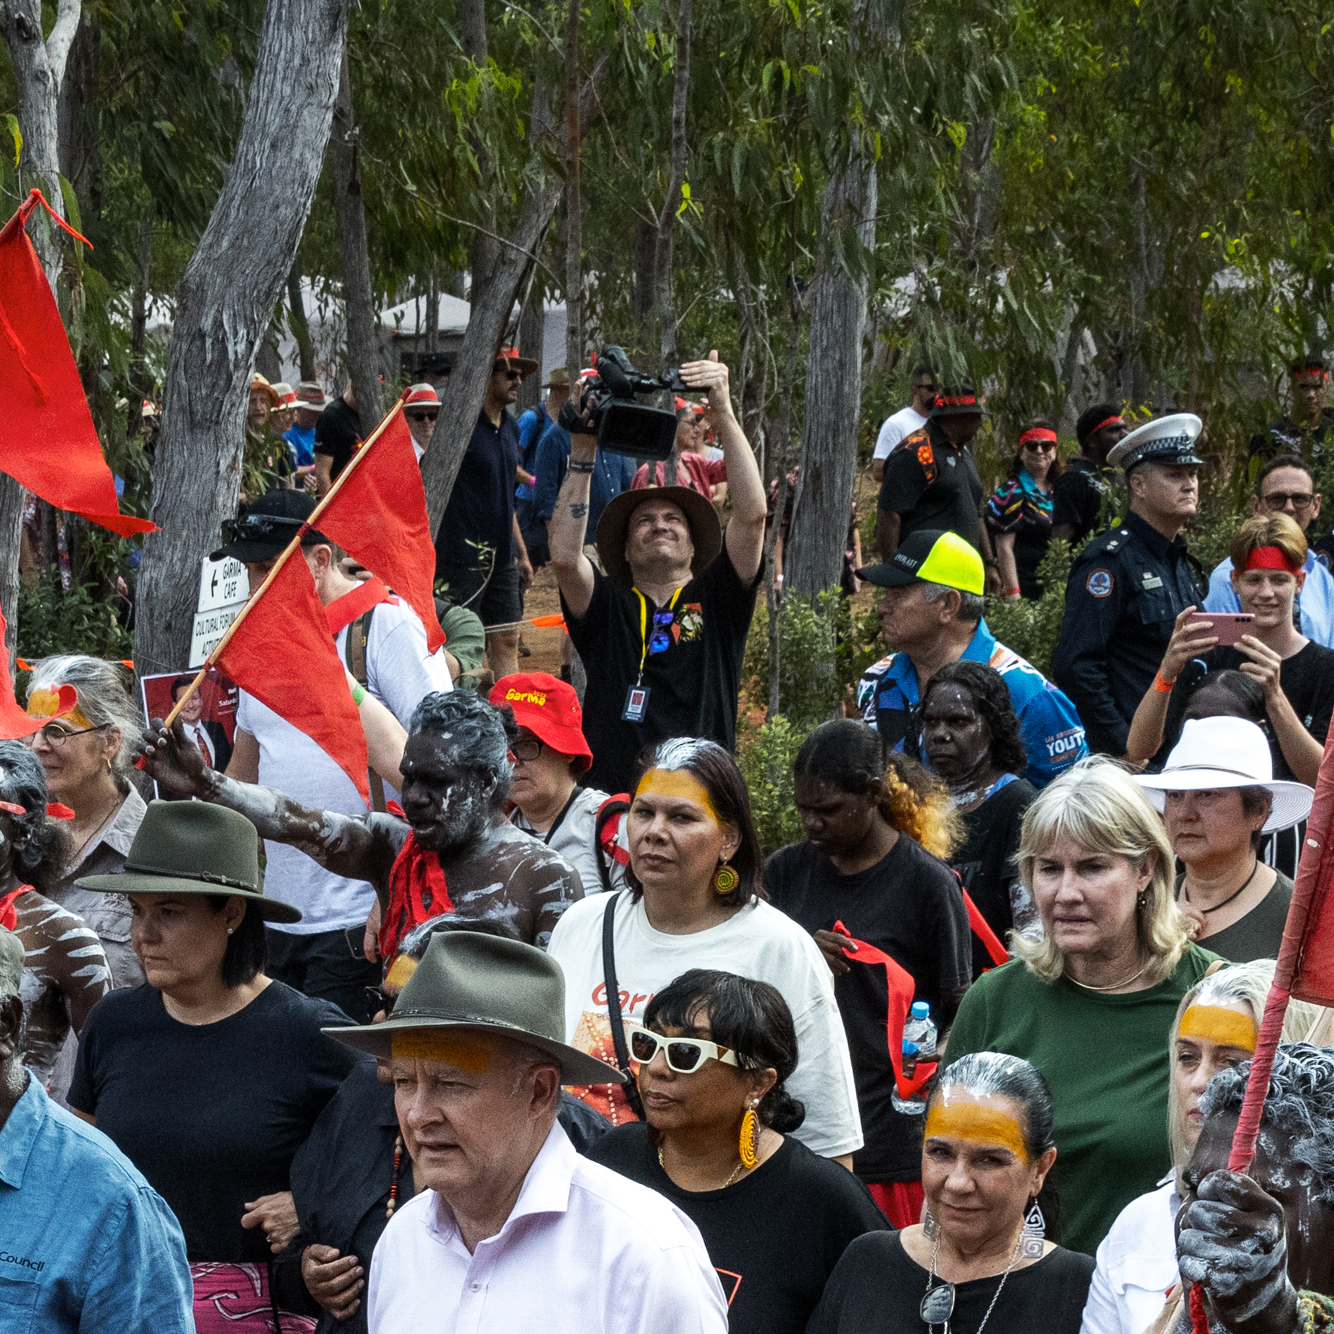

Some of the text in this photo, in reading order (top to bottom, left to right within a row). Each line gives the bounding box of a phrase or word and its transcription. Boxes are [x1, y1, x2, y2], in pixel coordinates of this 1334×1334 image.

[223, 561, 242, 580] GARMA
[224, 581, 237, 599] CAFE
[195, 616, 219, 637] CULTURAL
[505, 688, 546, 706] Garma
